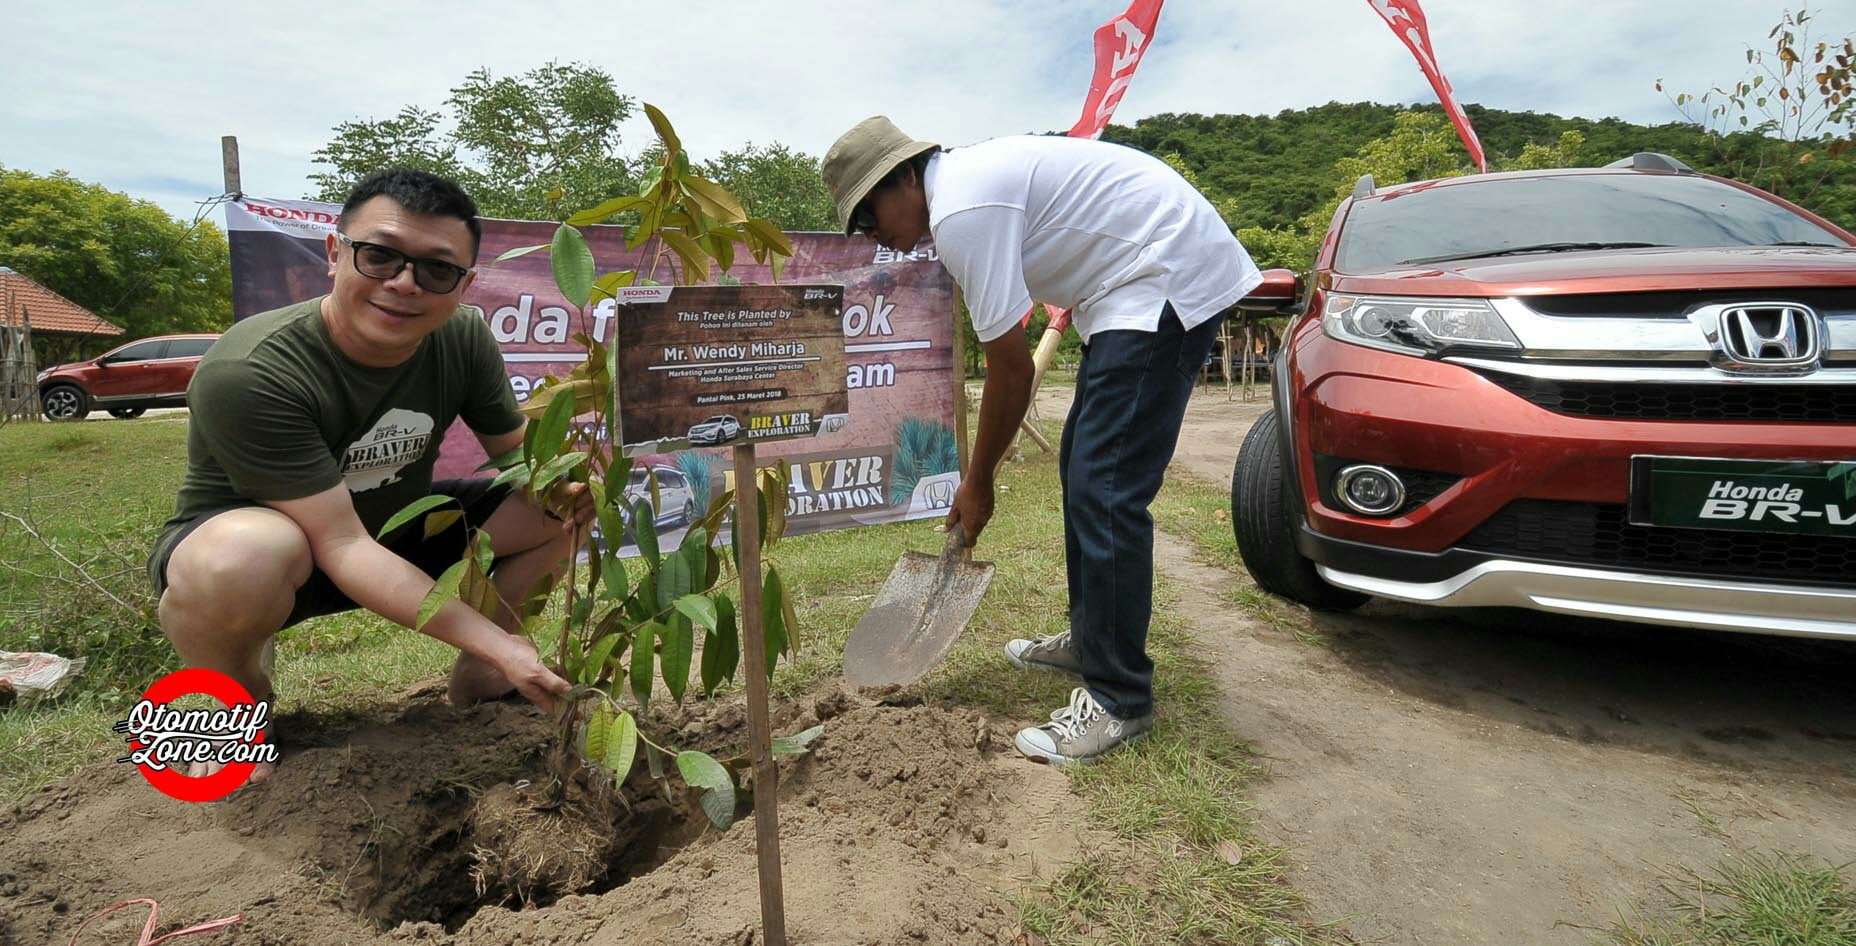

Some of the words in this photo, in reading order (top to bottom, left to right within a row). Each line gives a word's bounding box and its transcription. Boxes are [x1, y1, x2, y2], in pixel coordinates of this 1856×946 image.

[677, 311, 700, 321] This
[702, 311, 725, 320] Tree
[727, 310, 736, 320] is
[738, 309, 777, 320] Planted
[779, 309, 792, 320] by
[664, 347, 689, 361] Mr.
[693, 344, 747, 360] Wendy
[751, 341, 806, 357] Miharja
[668, 369, 702, 378] Marketing
[778, 363, 804, 371] Director
[724, 374, 753, 382] Surabaya
[754, 372, 776, 380] Center
[697, 395, 719, 404] Pantai
[746, 392, 765, 400] Maret
[766, 390, 782, 398] 2018
[751, 412, 810, 429] BRAVER
[374, 427, 416, 440] BR-V
[748, 424, 810, 438] EXPLORATION
[351, 437, 426, 463] BRAVER
[1708, 480, 1804, 502] Honda
[1699, 499, 1856, 525] BR-V
